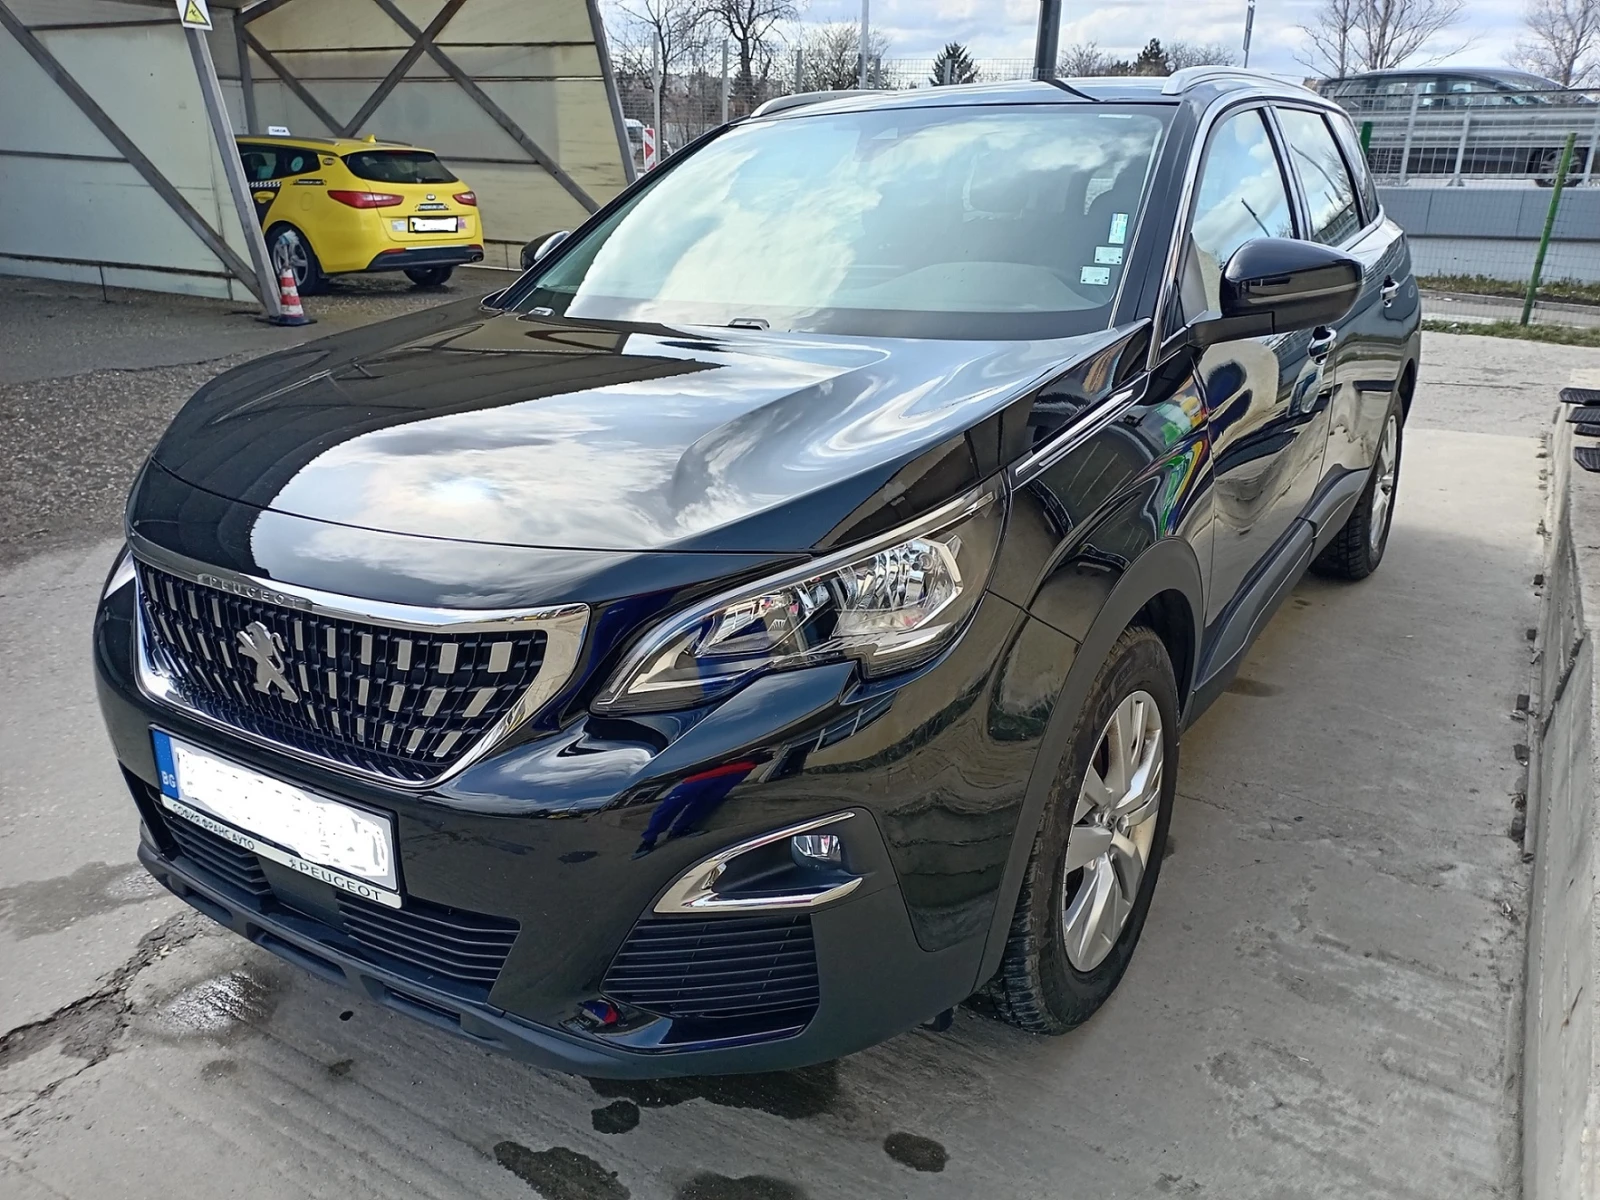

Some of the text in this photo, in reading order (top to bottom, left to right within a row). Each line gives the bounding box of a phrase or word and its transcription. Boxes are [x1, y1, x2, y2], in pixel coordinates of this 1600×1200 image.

[209, 576, 299, 608] PEUGEOT
[161, 770, 176, 789] BG
[299, 862, 381, 900] PEUGEOT
